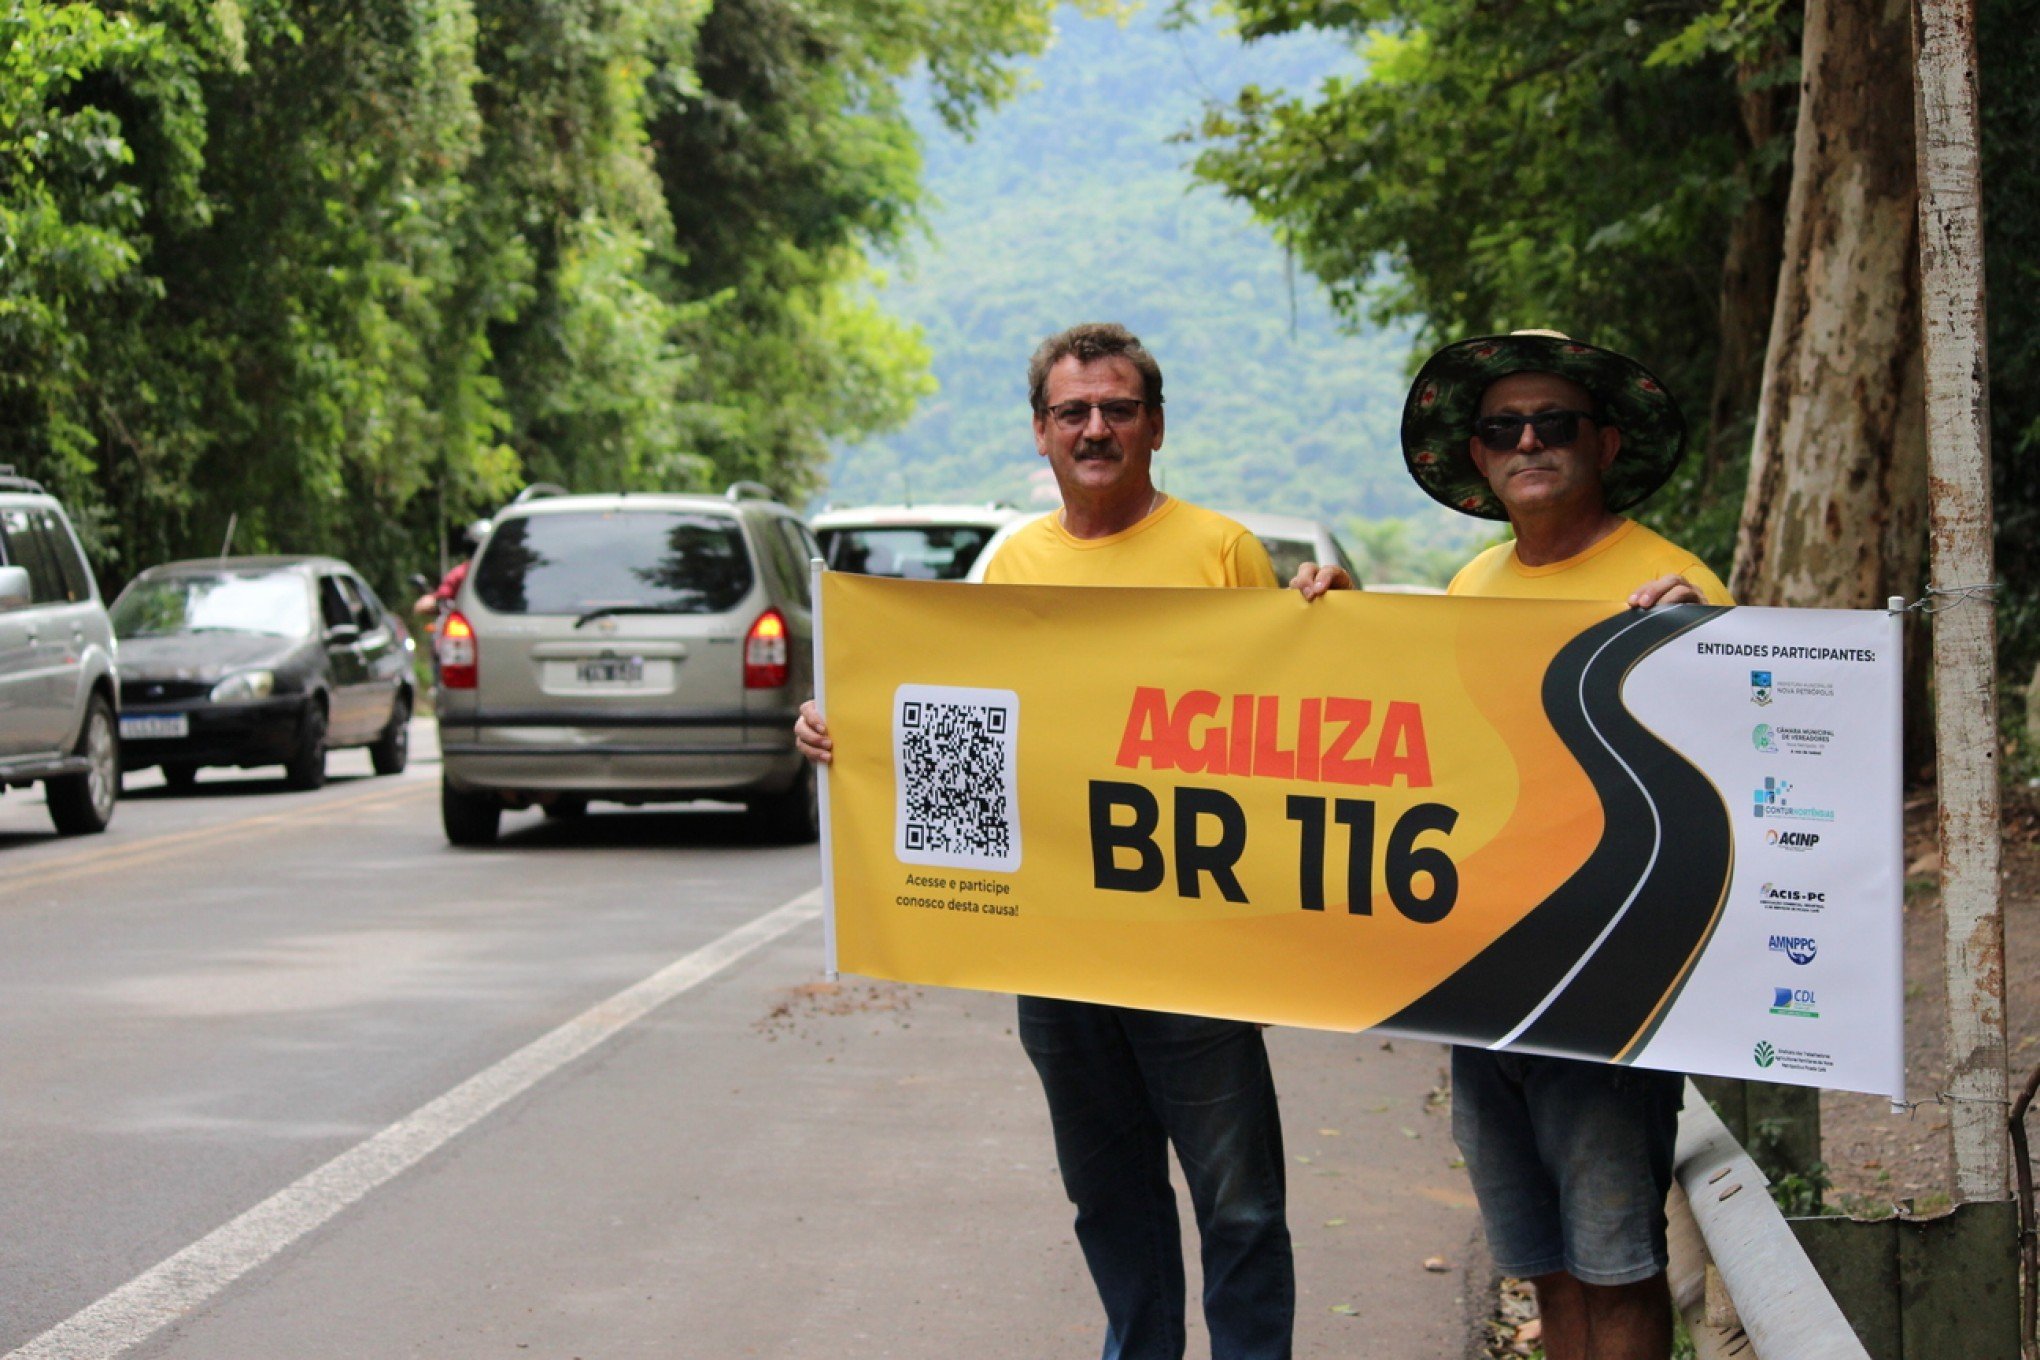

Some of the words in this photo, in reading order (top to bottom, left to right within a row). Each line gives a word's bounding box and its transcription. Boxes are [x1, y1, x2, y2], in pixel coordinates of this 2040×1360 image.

[1697, 642, 1768, 657] ENTIDADES
[1772, 646, 1876, 662] PARTICIPANTES:
[1115, 686, 1434, 788] AGILIZA
[1791, 735, 1830, 743] VEREADORES
[1803, 729, 1834, 737] MUNICIPAL
[1779, 831, 1820, 847] ACINP
[1088, 779, 1250, 905] BR
[1286, 795, 1460, 925] 116
[905, 873, 946, 889] Acesse
[949, 879, 956, 889] e
[959, 879, 1010, 896] participe
[1769, 889, 1825, 902] ACIS-PC
[896, 896, 945, 909] conosco
[947, 899, 980, 913] desta
[982, 904, 1019, 917] causa!
[1768, 935, 1816, 951] AMNPPC
[1794, 989, 1816, 1004] CDL
